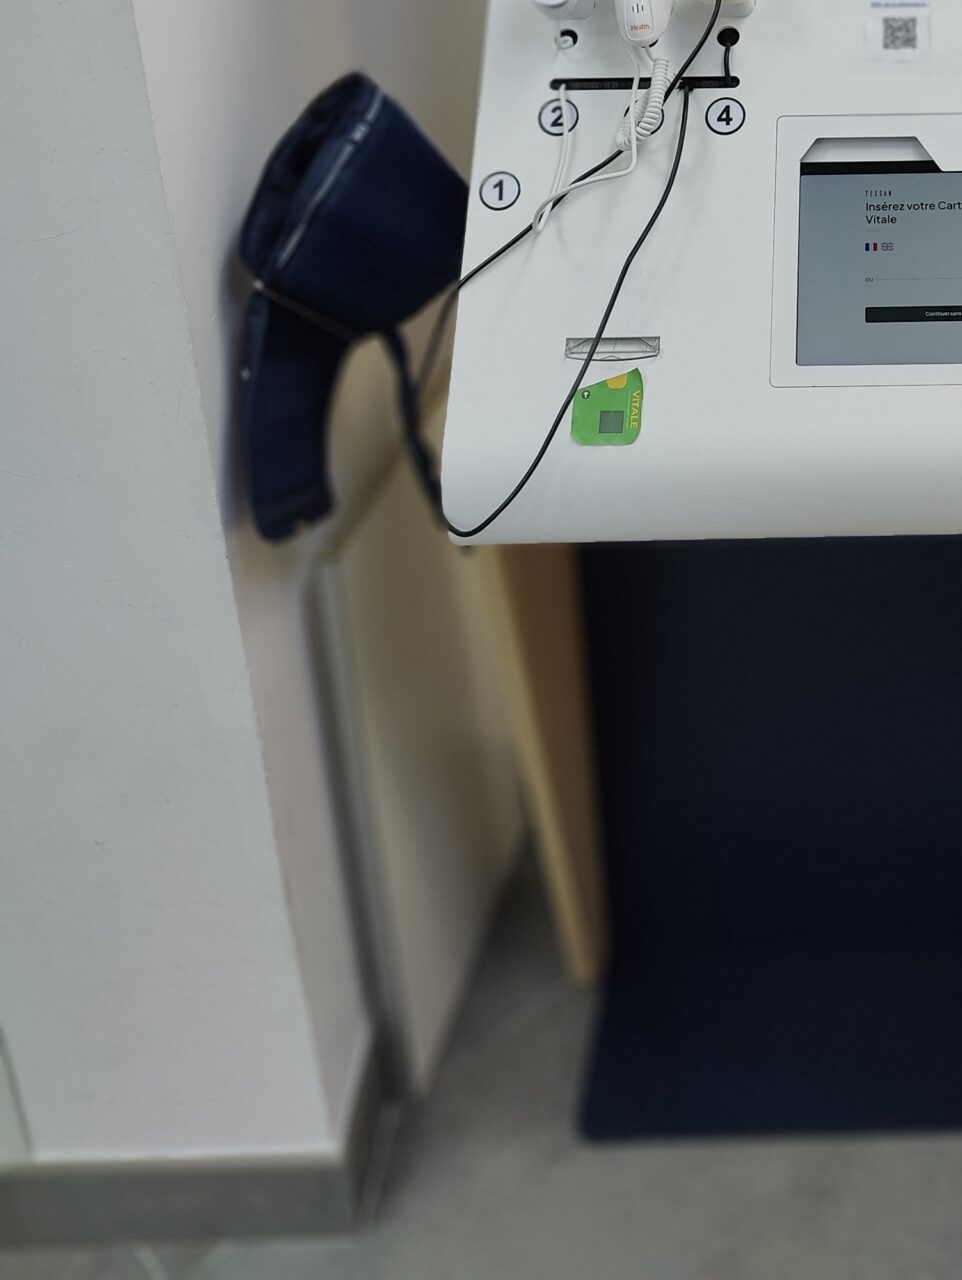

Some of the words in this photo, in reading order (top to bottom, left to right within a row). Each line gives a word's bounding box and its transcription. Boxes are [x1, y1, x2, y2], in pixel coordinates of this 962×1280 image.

[550, 106, 565, 127] 2
[716, 105, 733, 126] 4
[492, 180, 503, 201] 1
[866, 202, 905, 212] Insérez
[906, 202, 935, 211] votre
[866, 214, 897, 224] Vitale
[631, 390, 640, 429] VITALE
